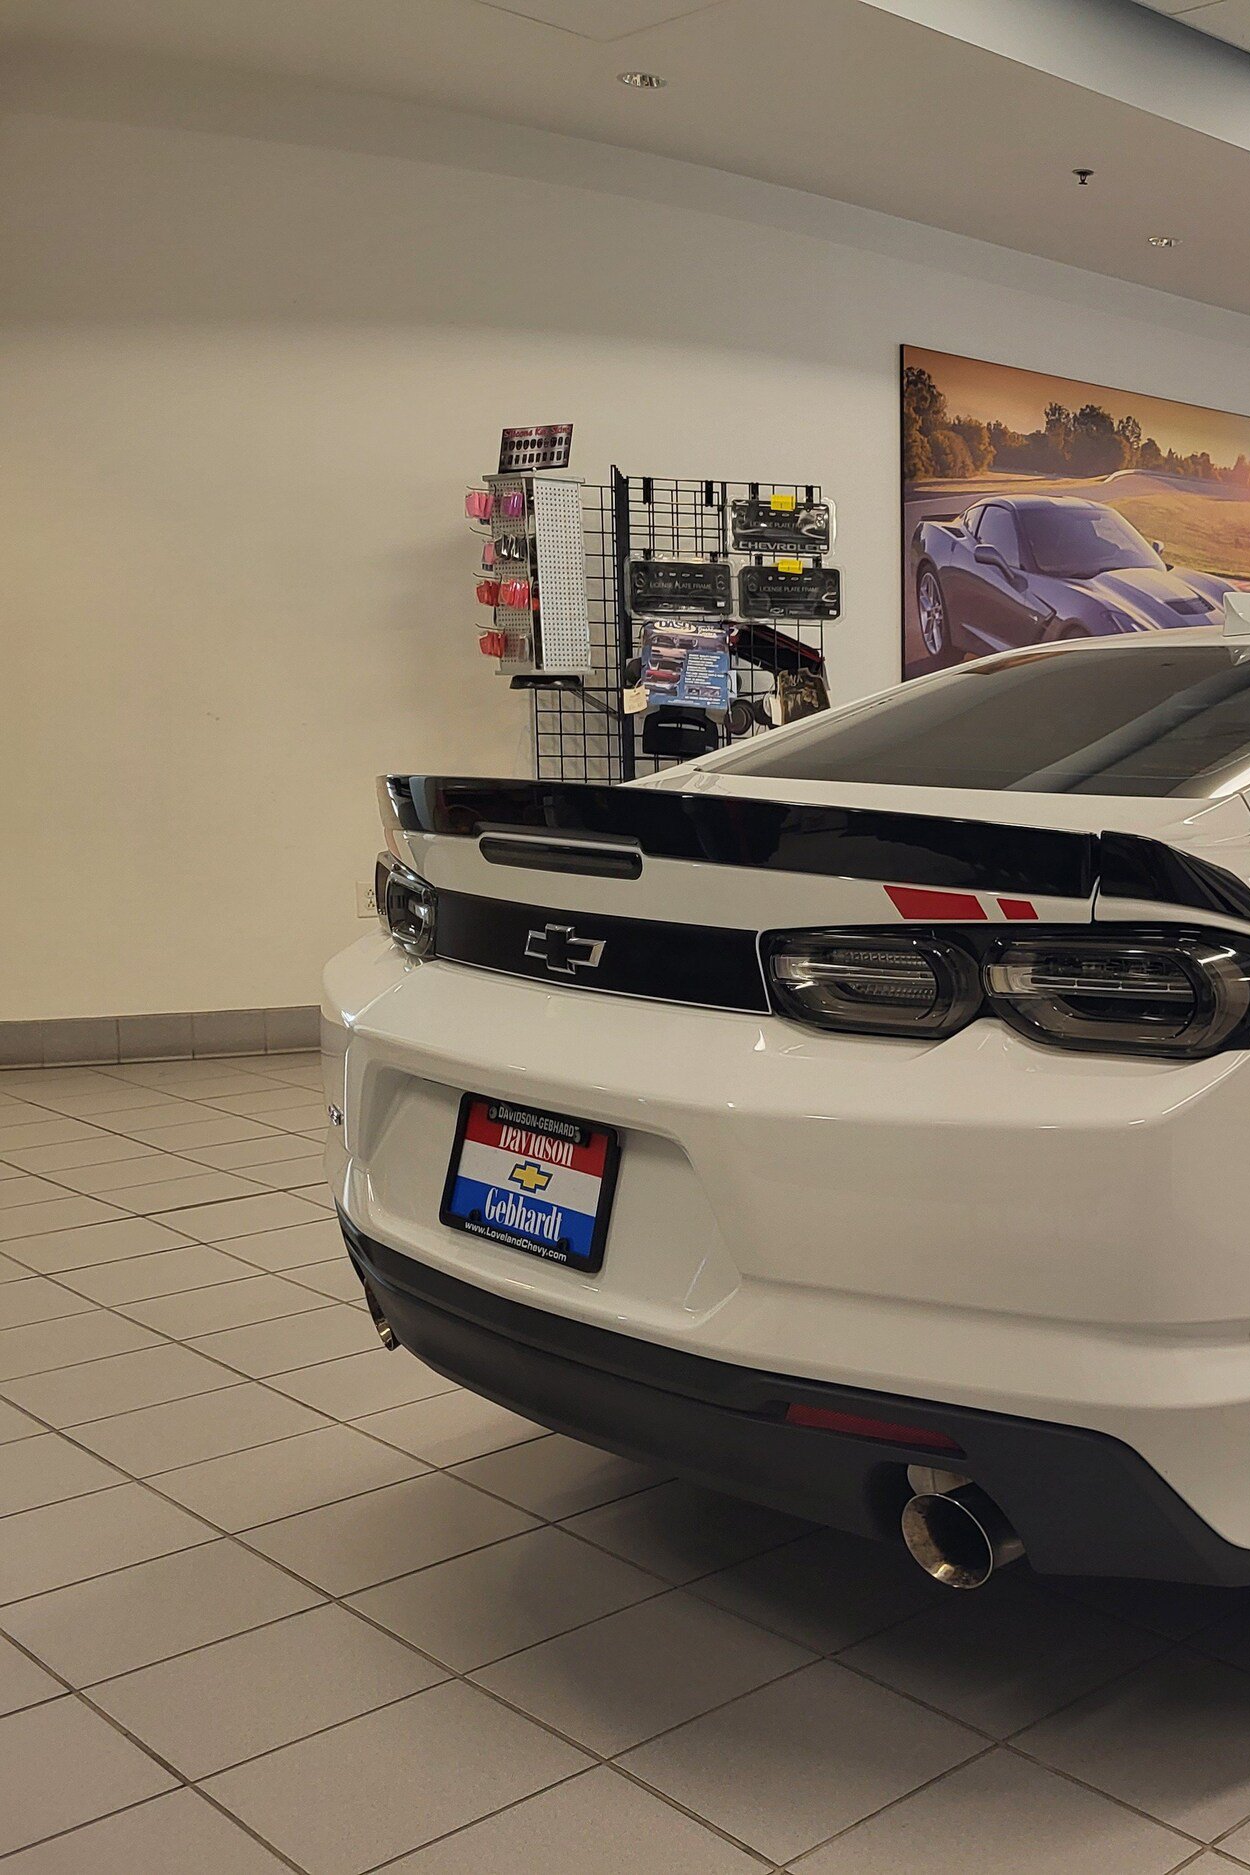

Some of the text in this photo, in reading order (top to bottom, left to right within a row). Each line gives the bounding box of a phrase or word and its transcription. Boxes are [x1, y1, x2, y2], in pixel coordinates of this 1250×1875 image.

[498, 1125, 574, 1167] Davidson
[485, 1187, 563, 1242] Gebhardt
[464, 1220, 567, 1262] www.LovelandChevy.com
